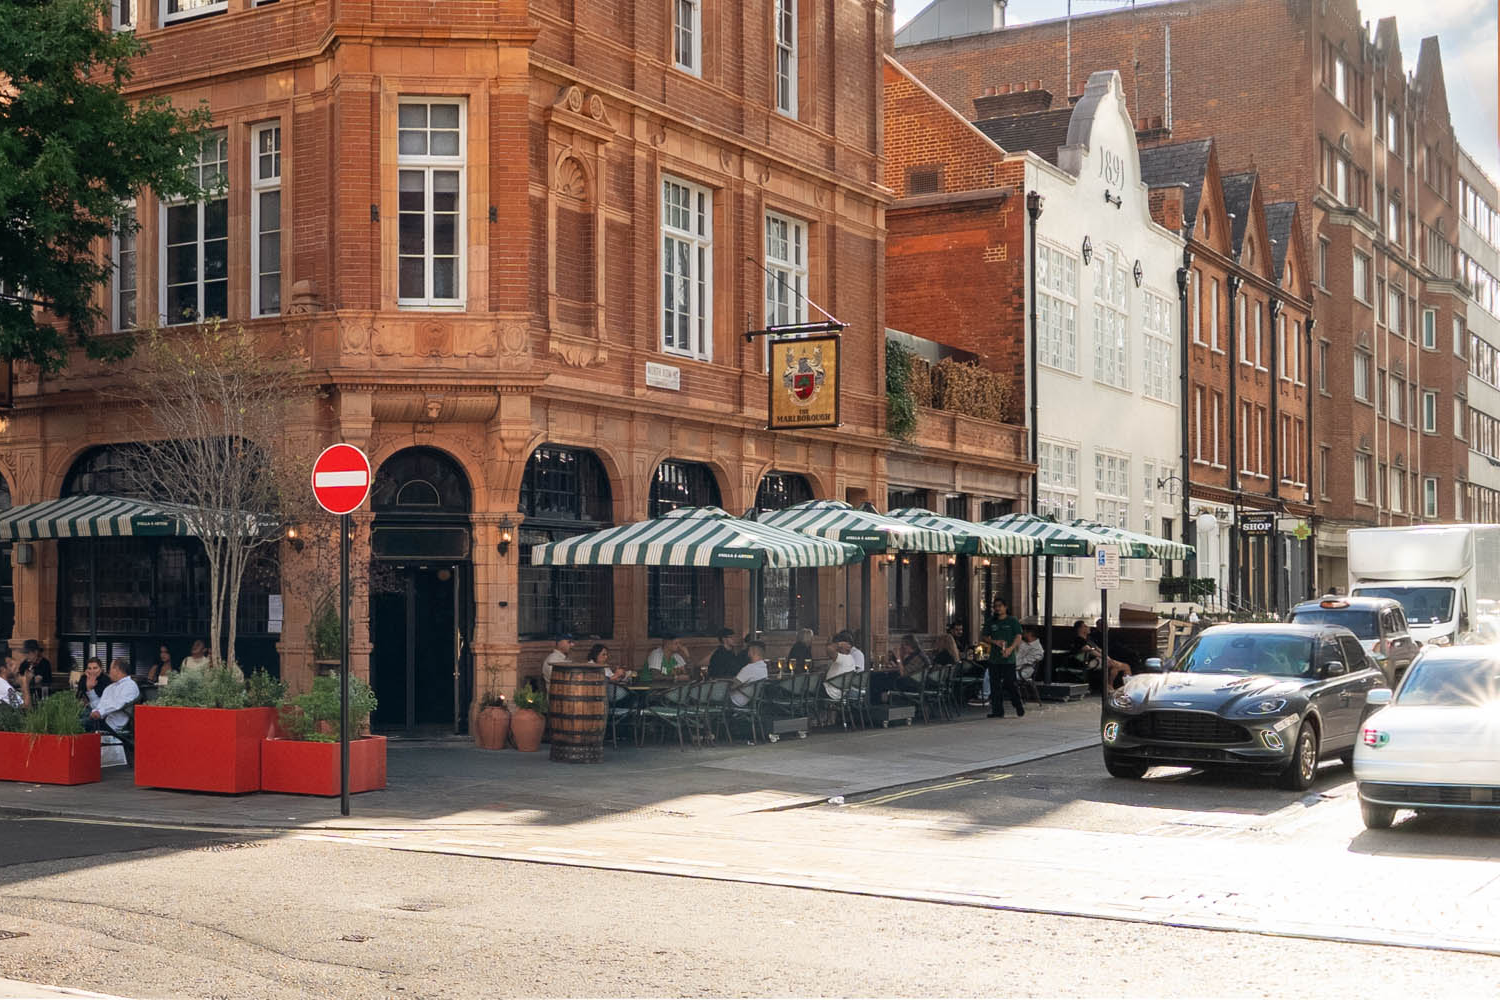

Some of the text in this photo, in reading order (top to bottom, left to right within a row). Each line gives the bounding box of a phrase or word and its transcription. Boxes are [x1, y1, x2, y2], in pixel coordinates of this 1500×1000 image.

[1098, 145, 1124, 191] 1891
[777, 413, 831, 423] MARLBOROUGH
[1242, 522, 1272, 531] SHOP
